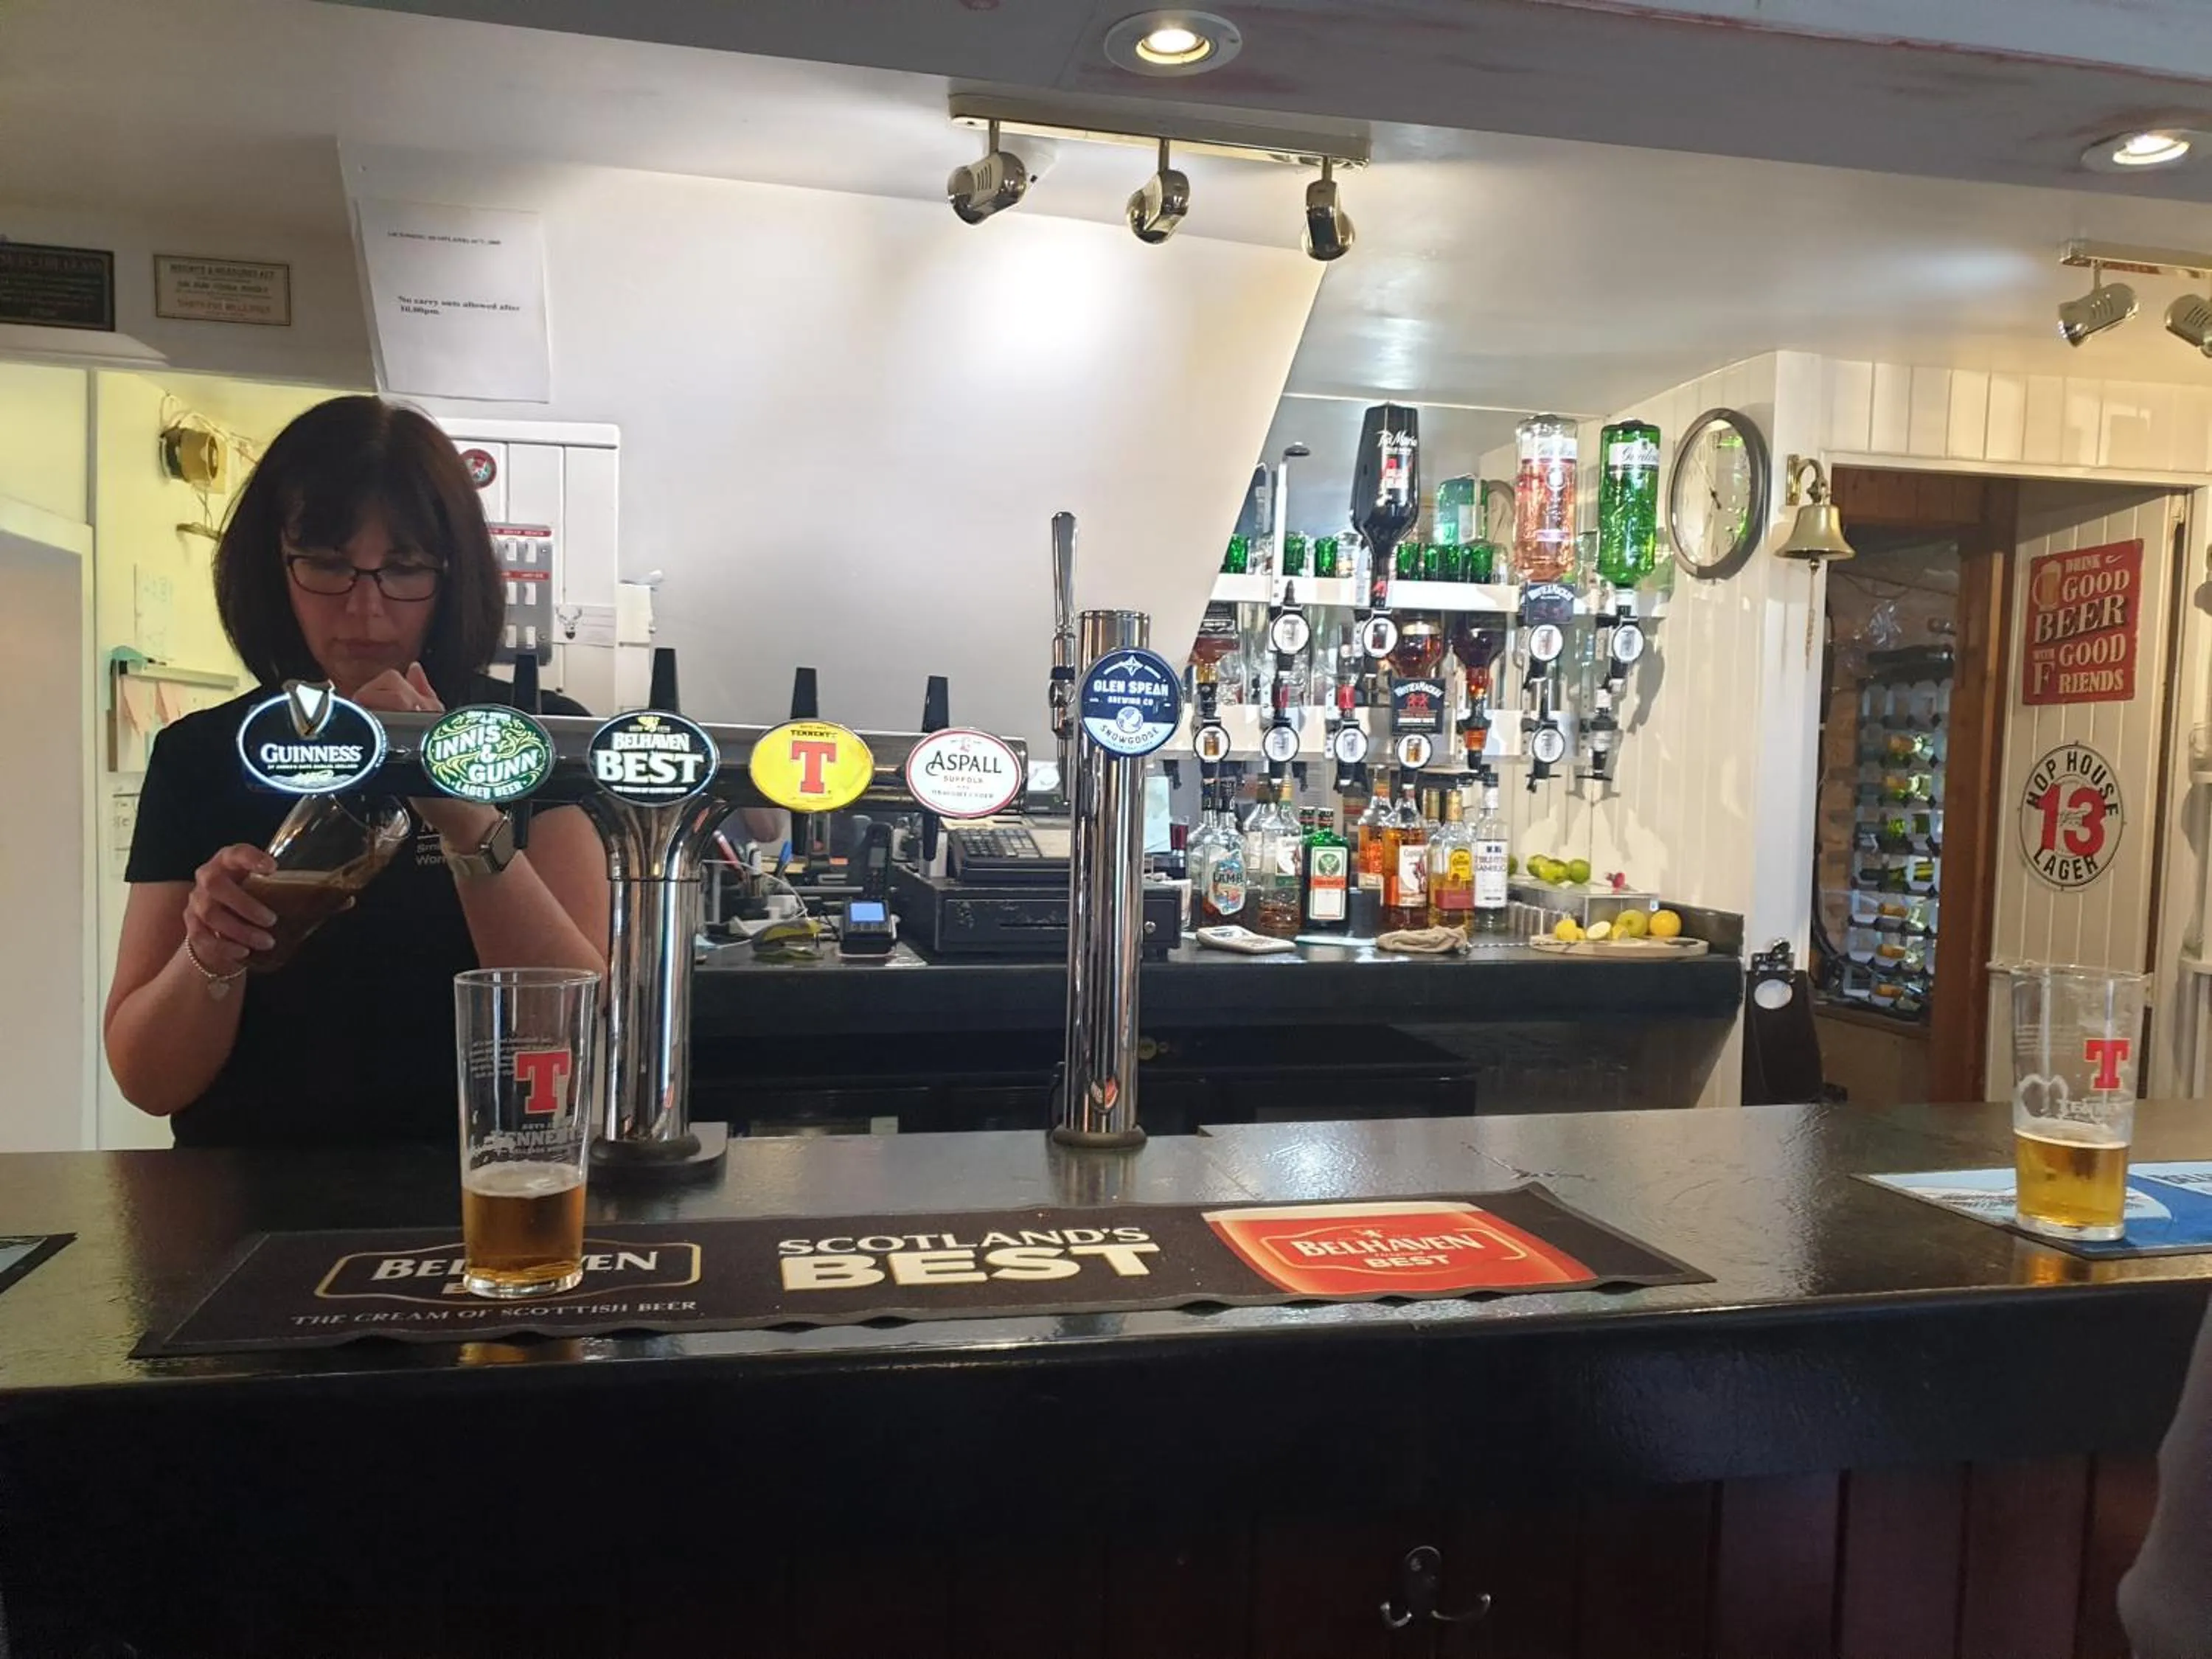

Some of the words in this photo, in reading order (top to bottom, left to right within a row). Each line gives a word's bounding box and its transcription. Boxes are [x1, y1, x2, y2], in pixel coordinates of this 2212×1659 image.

[414, 299, 439, 307] carry
[462, 302, 497, 310] allowed
[499, 303, 521, 311] after
[2062, 569, 2130, 602] GOOD
[2034, 594, 2125, 644] BEER
[2059, 633, 2126, 667] GOOD
[1093, 679, 1126, 693] GLEN
[1128, 681, 1169, 697] SPEAN
[436, 725, 501, 761] INNIS
[612, 731, 690, 752] BELHAVEN
[1100, 724, 1161, 745] SNOWGOOSE
[260, 742, 364, 764] GUINNESS
[468, 748, 540, 783] GUNN
[479, 744, 497, 764] &
[594, 749, 705, 785] BEST
[790, 740, 836, 794] T
[925, 750, 1002, 776] ASPALL
[454, 782, 490, 799] LAGER
[493, 780, 524, 797] BEER
[2026, 759, 2057, 810] HOP
[2067, 751, 2118, 816] HOUSE
[2036, 782, 2107, 857] 13
[2034, 845, 2098, 880] LAGER
[2084, 1038, 2130, 1091] T
[514, 1048, 572, 1115] T
[778, 1226, 1152, 1255] SCOTLAND'S
[1290, 1234, 1486, 1257] BELHAVEN
[781, 1242, 1161, 1291] BEST
[1363, 1254, 1451, 1268] BEST
[290, 1313, 347, 1325] THE
[353, 1310, 449, 1322] CREAM
[456, 1308, 493, 1319] OF
[501, 1304, 627, 1316] SCOTTISH
[637, 1301, 697, 1312] BEER
